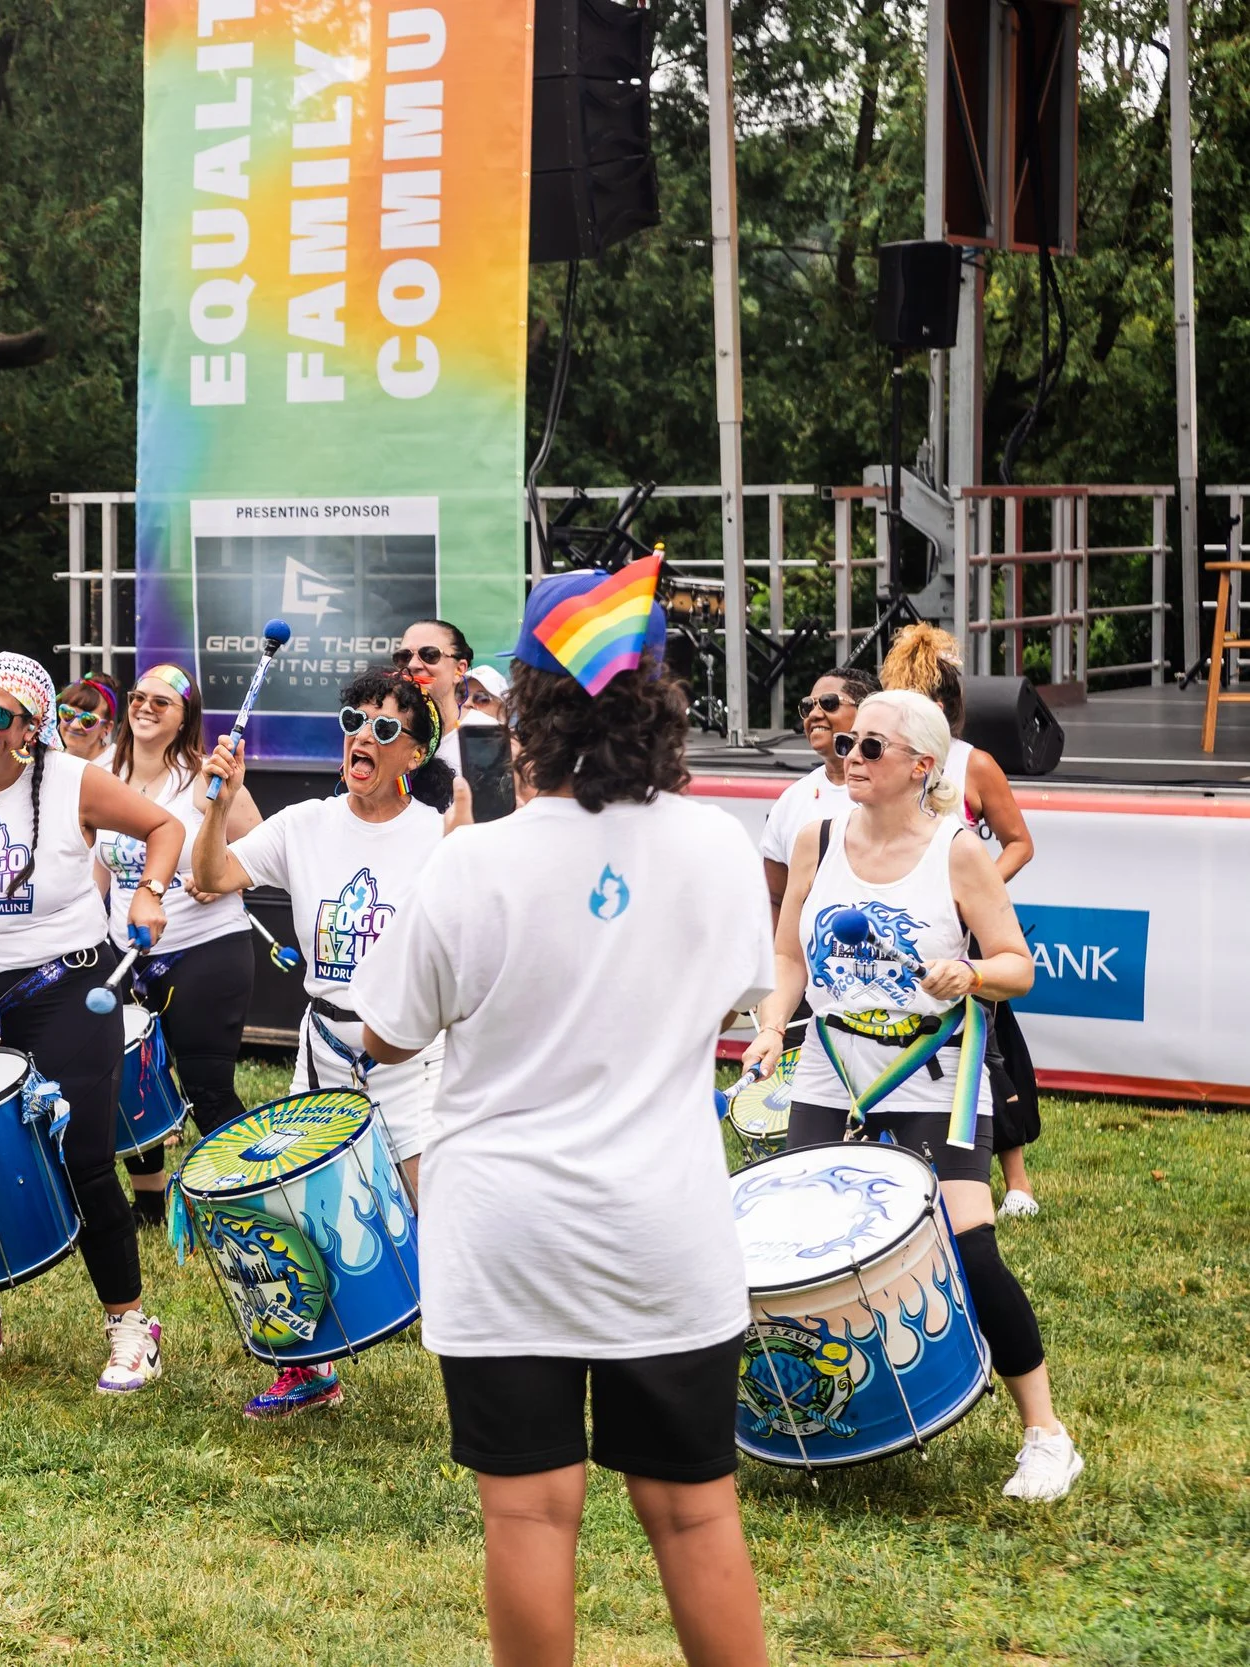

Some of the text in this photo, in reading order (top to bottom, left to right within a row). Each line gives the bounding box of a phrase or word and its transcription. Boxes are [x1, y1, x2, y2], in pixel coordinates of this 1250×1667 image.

[287, 39, 353, 402] FAMILY
[236, 505, 390, 518] PRESENTING SPONSOR
[320, 636, 404, 654] THEOR
[209, 677, 342, 686] EVEY BODY
[318, 903, 393, 933] FOGO
[317, 931, 380, 964] AZU
[1034, 942, 1119, 982] ANK
[318, 965, 331, 976] NJ
[874, 977, 908, 1007] AZUL
[300, 1106, 336, 1115] AZUL
[337, 1107, 362, 1118] NYC
[267, 1304, 311, 1337] AZUL
